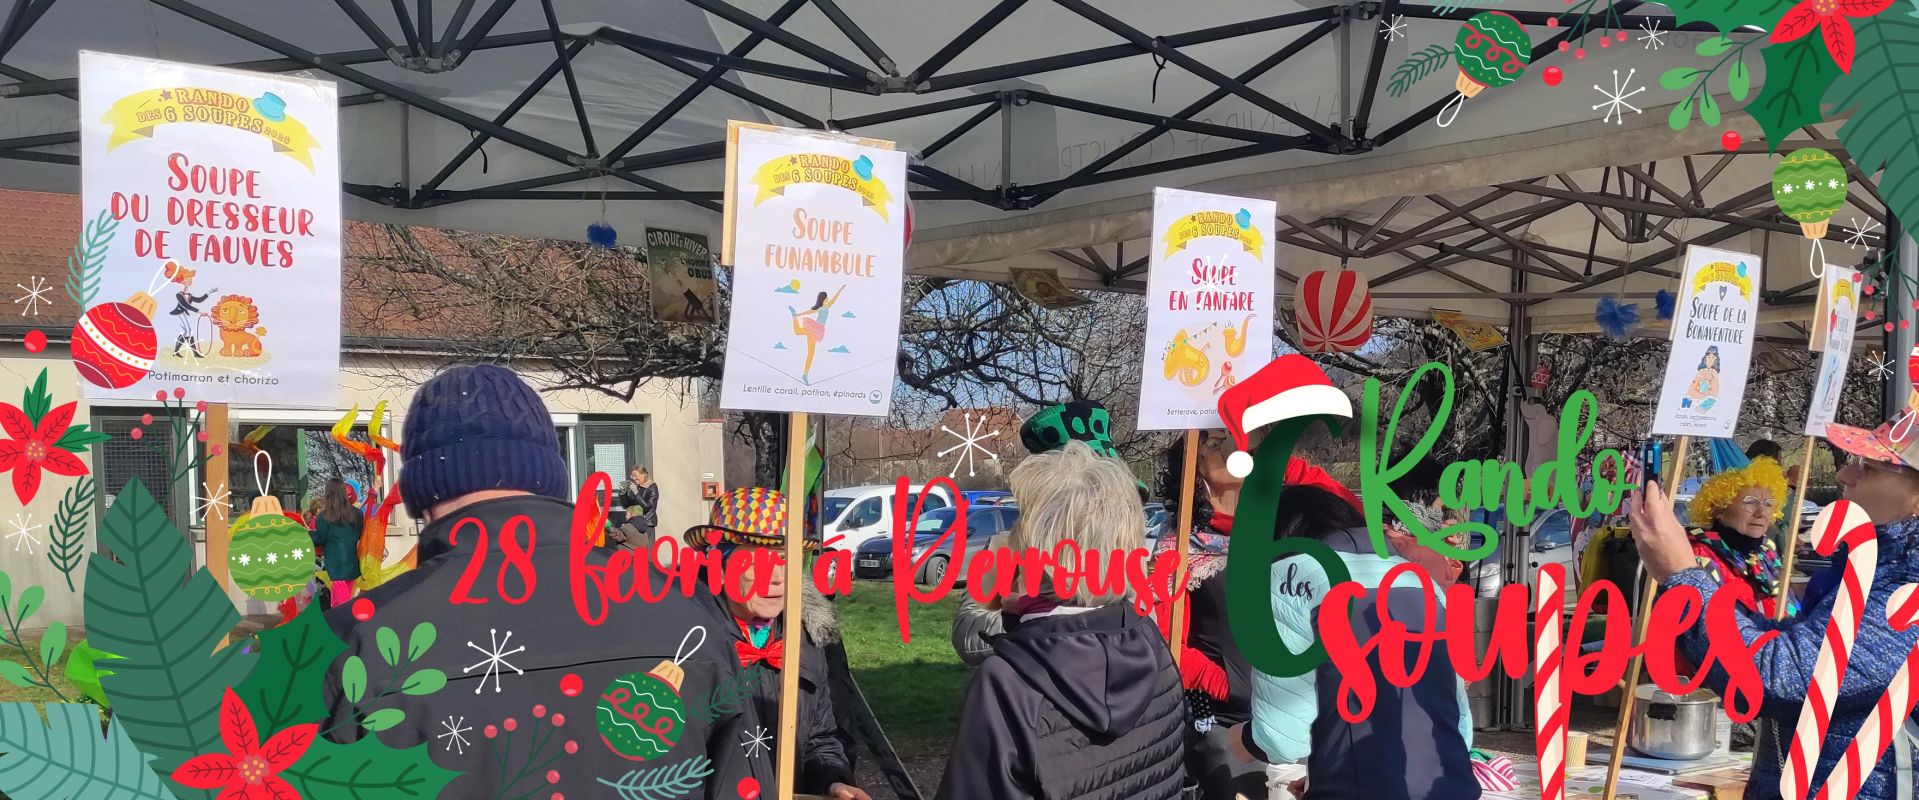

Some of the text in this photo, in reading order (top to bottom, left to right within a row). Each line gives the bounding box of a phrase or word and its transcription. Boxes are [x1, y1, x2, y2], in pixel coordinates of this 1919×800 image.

[175, 88, 250, 113] RANDO
[137, 105, 291, 145] DES 6 SOUPES 2025
[168, 152, 261, 199] SOUPE
[799, 154, 850, 174] RANDO
[791, 169, 801, 183] 6
[804, 168, 858, 191] SOUPES
[111, 191, 315, 237] DU DRESSEUR
[792, 207, 854, 245] SOUPE
[1197, 212, 1233, 225] RANDO
[647, 231, 680, 248] CIRQUE
[1191, 226, 1198, 238] 6
[1201, 224, 1240, 240] SOUPES
[134, 228, 294, 268] DE FAUVES
[764, 243, 877, 278] FUNAMBULE
[1169, 290, 1188, 311] EN
[1689, 296, 1747, 324] SOUPE DE LA
[1686, 319, 1744, 345] BONAVENTURE
[148, 370, 280, 386] Potimarron et chorizo
[742, 383, 772, 394] Lentille
[833, 388, 867, 400] épinards
